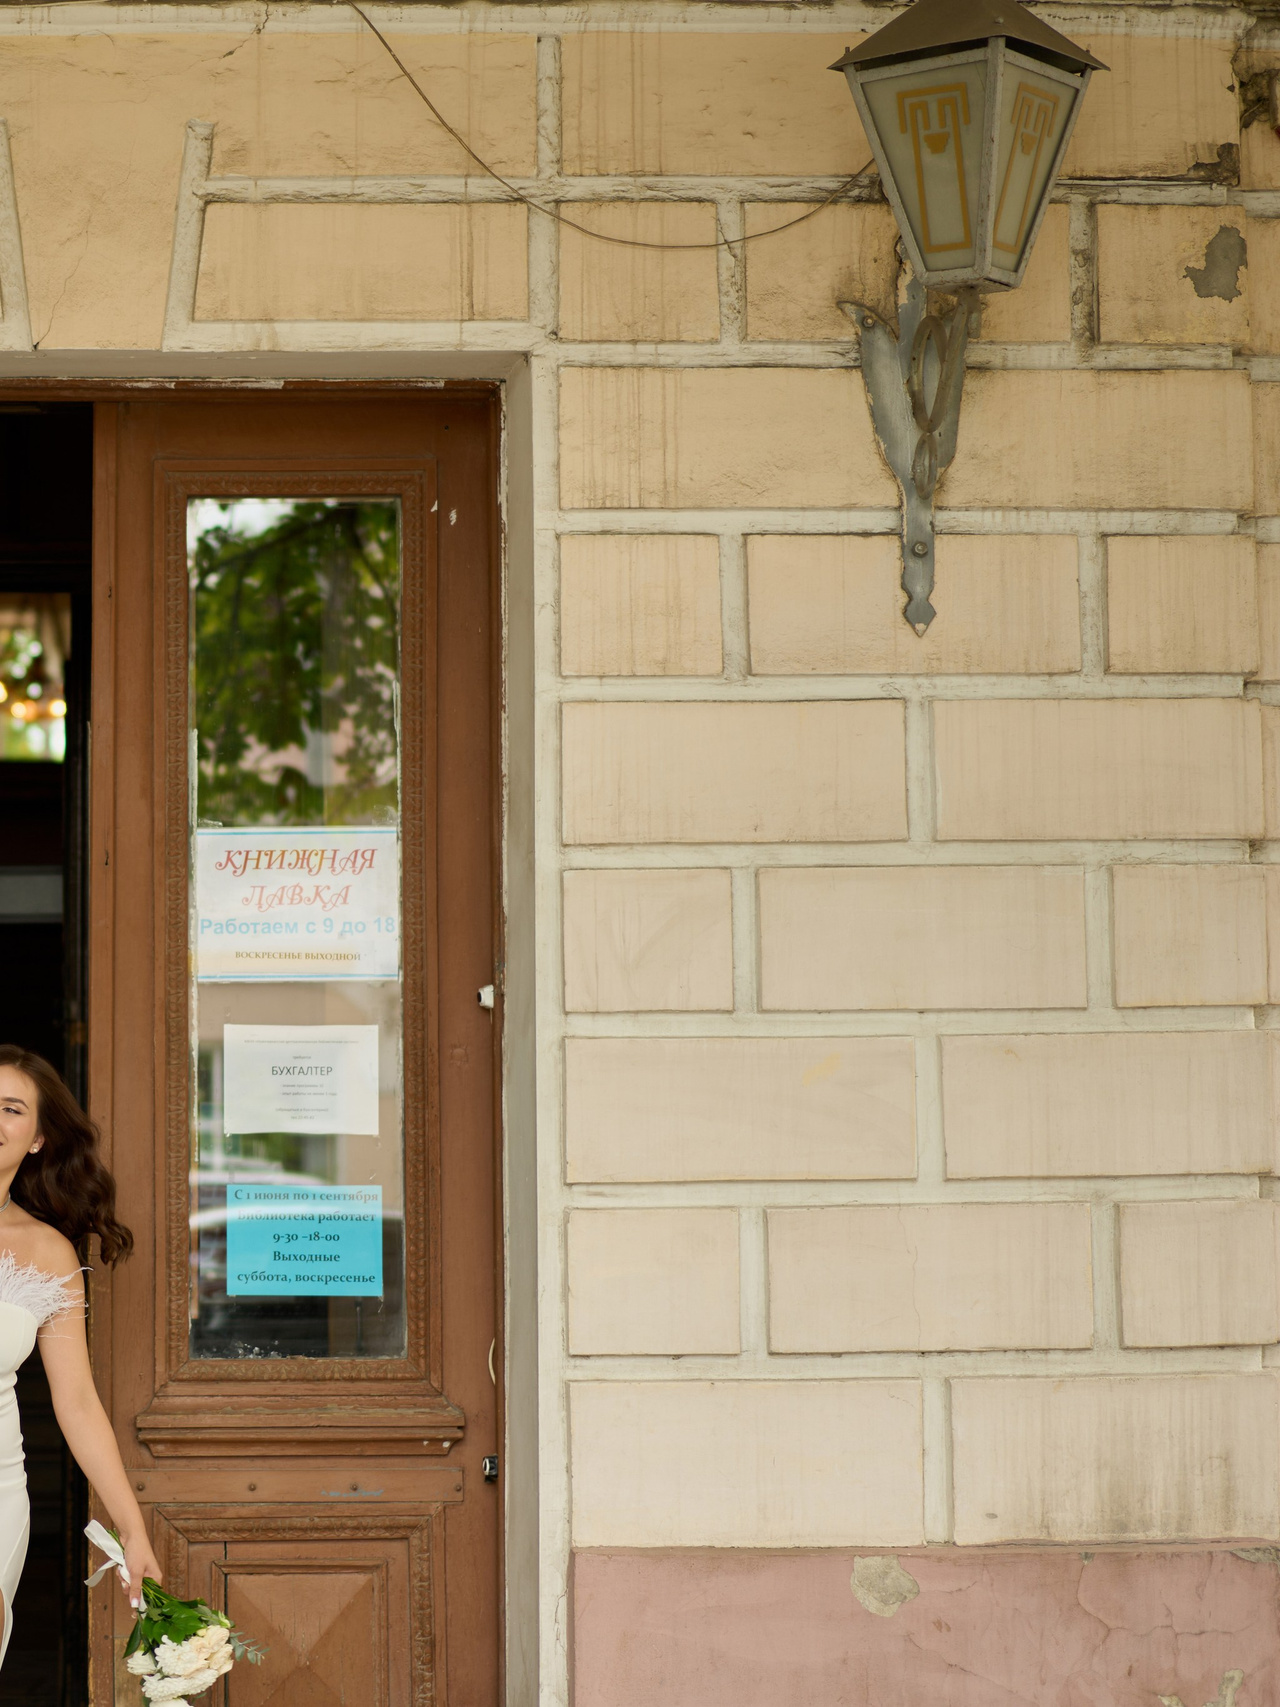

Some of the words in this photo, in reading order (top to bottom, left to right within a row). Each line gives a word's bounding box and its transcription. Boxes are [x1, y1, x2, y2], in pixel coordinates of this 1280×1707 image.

[215, 848, 378, 877] КНИЖНАЯ
[242, 883, 352, 912] ЛАВКА
[200, 918, 298, 934] Работаем
[306, 921, 316, 934] с
[323, 918, 334, 934] 9
[341, 920, 366, 936] до
[374, 917, 396, 933] 18
[235, 951, 302, 960] ВОСКРЕСЕНЬЕ
[304, 952, 361, 961] ВЫХОДНОЙ
[271, 1066, 333, 1076] БУХГАЛТЕР
[234, 1189, 243, 1200] С
[246, 1192, 251, 1200] 1
[254, 1192, 290, 1200] июня
[293, 1192, 309, 1200] по
[312, 1192, 317, 1200] 1
[320, 1190, 378, 1203] сентября
[238, 1210, 315, 1221] Библиотека
[318, 1210, 376, 1224] работает
[273, 1232, 298, 1244] 9-30
[273, 1250, 340, 1264] Выходные
[237, 1270, 292, 1284] суббота,
[295, 1272, 376, 1285] воскресенье
